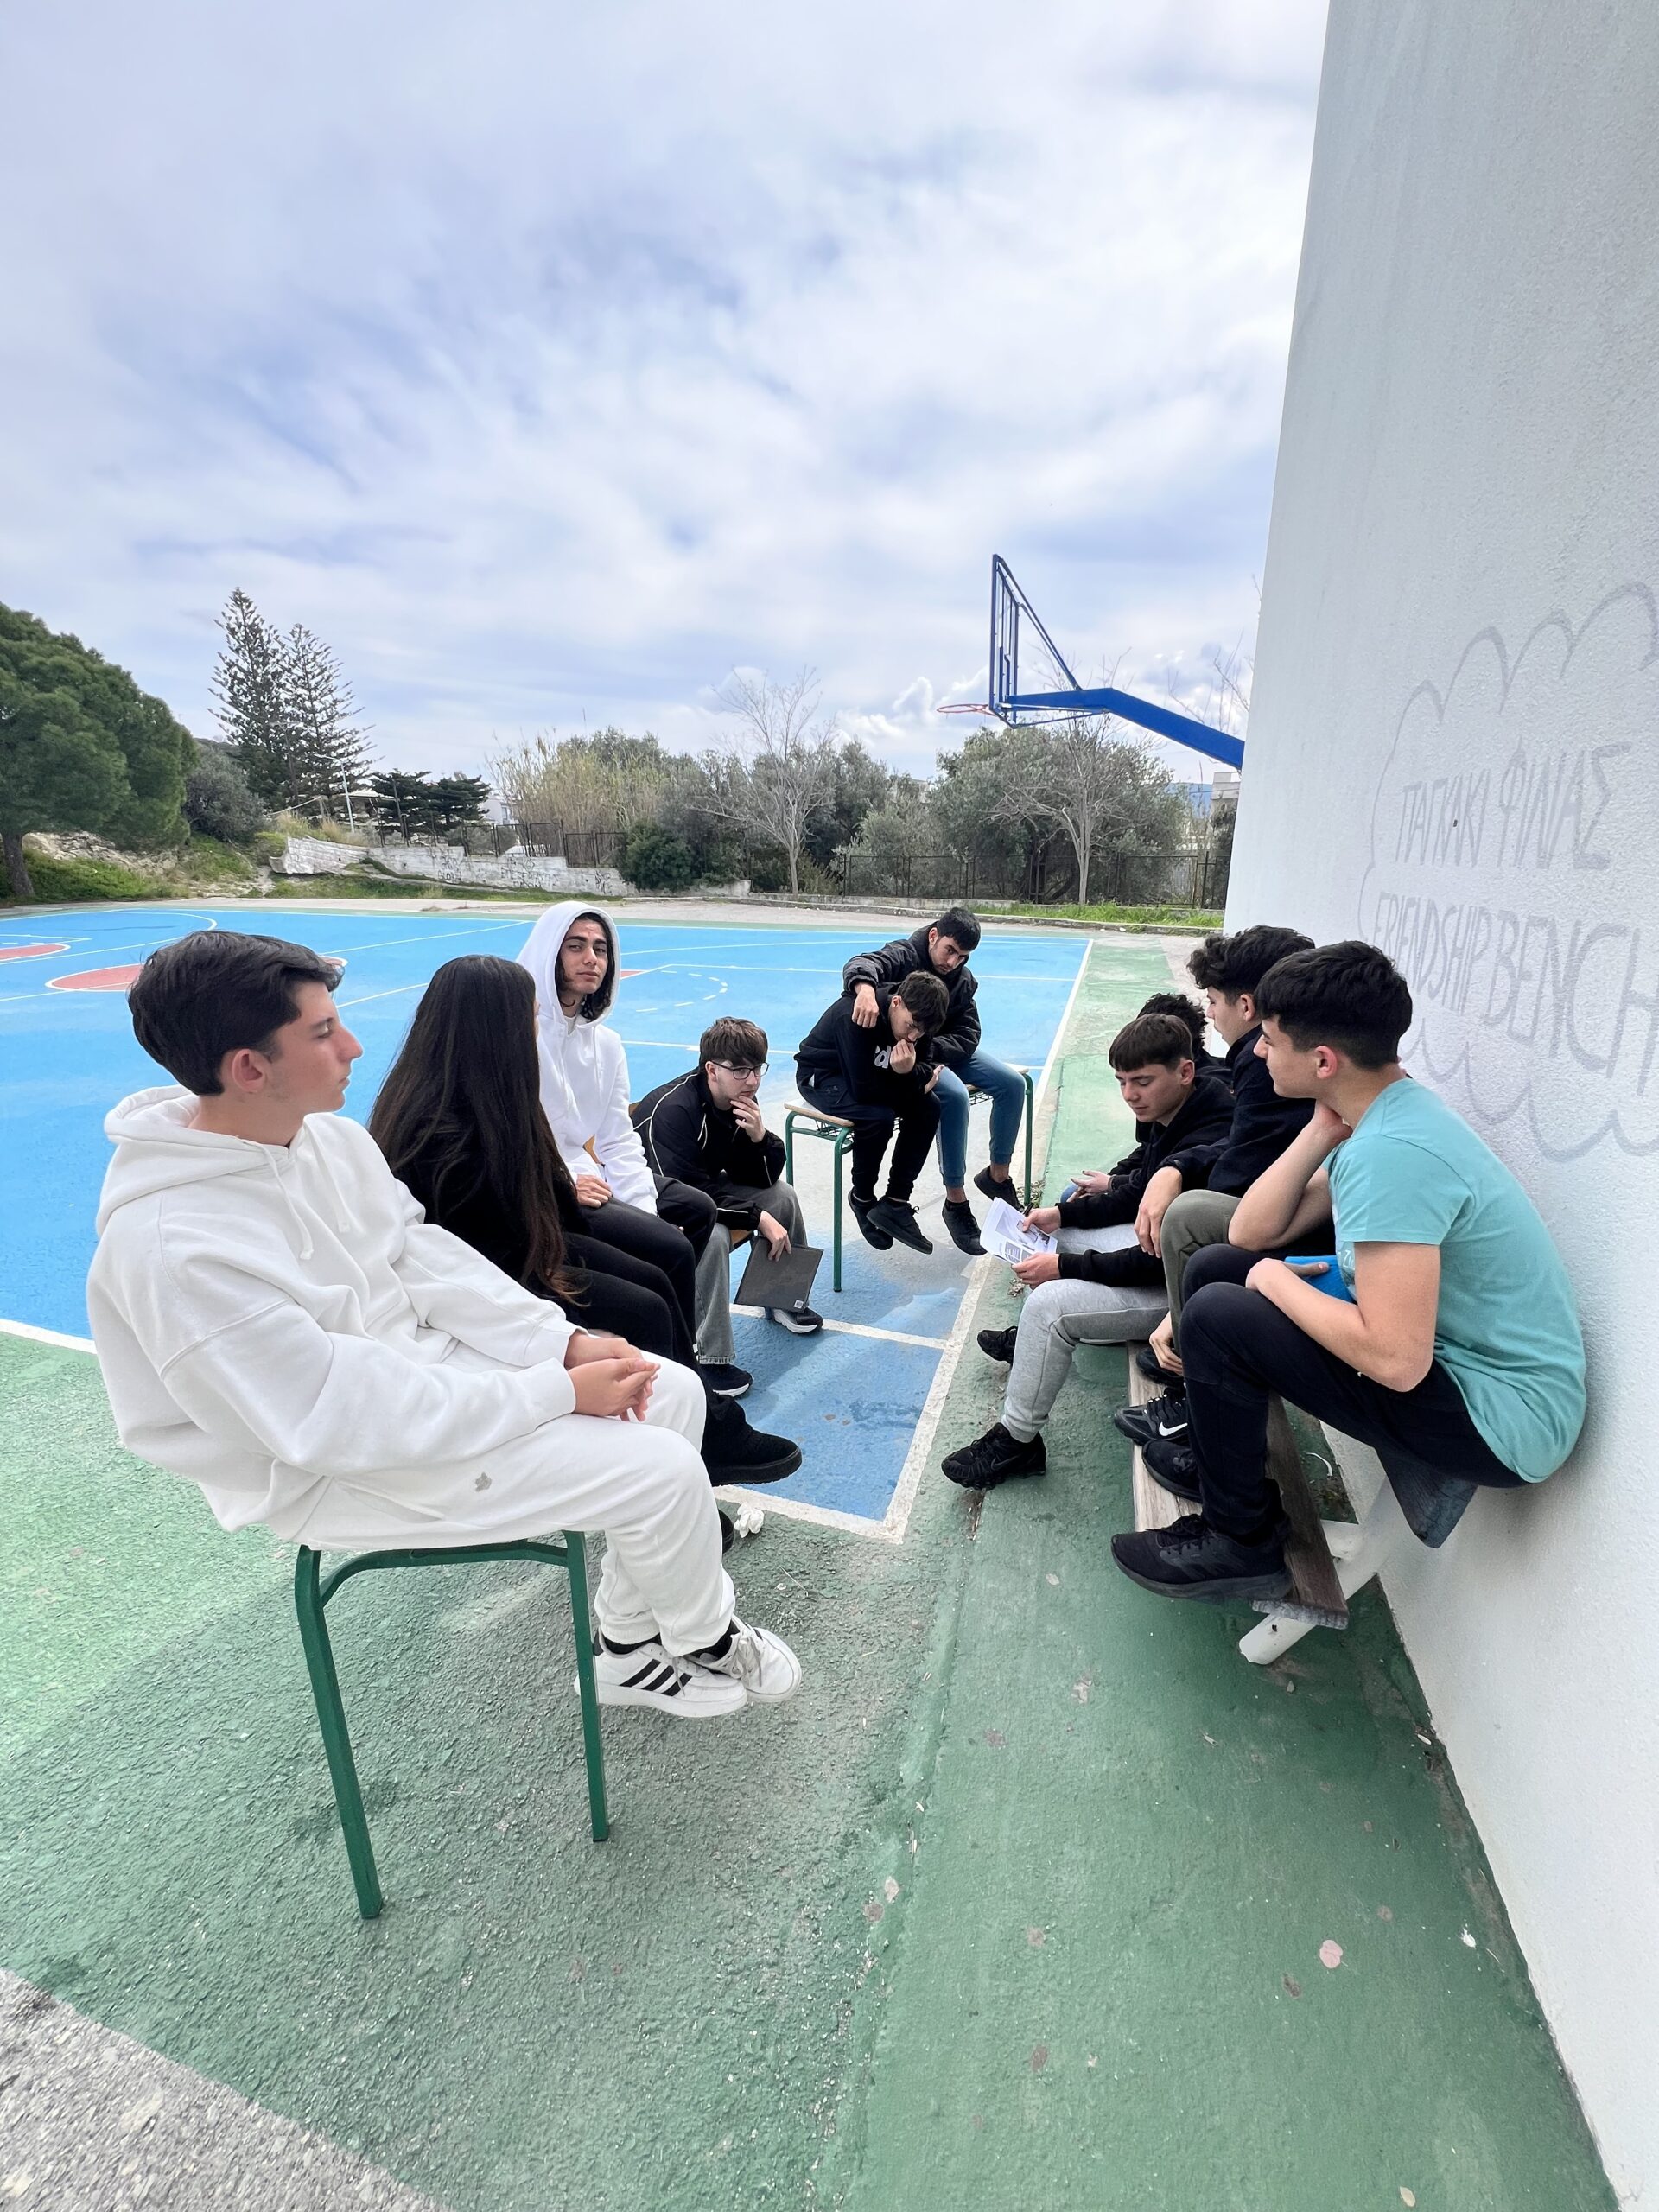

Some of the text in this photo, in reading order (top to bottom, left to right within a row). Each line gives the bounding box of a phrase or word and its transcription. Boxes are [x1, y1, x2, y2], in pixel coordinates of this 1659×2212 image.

[1395, 735, 1633, 869] ΠΑΓΚΑΚΙ ΦΙΛΙΑΣ
[1372, 890, 1659, 1096] FRIENDSHIP BENCH
